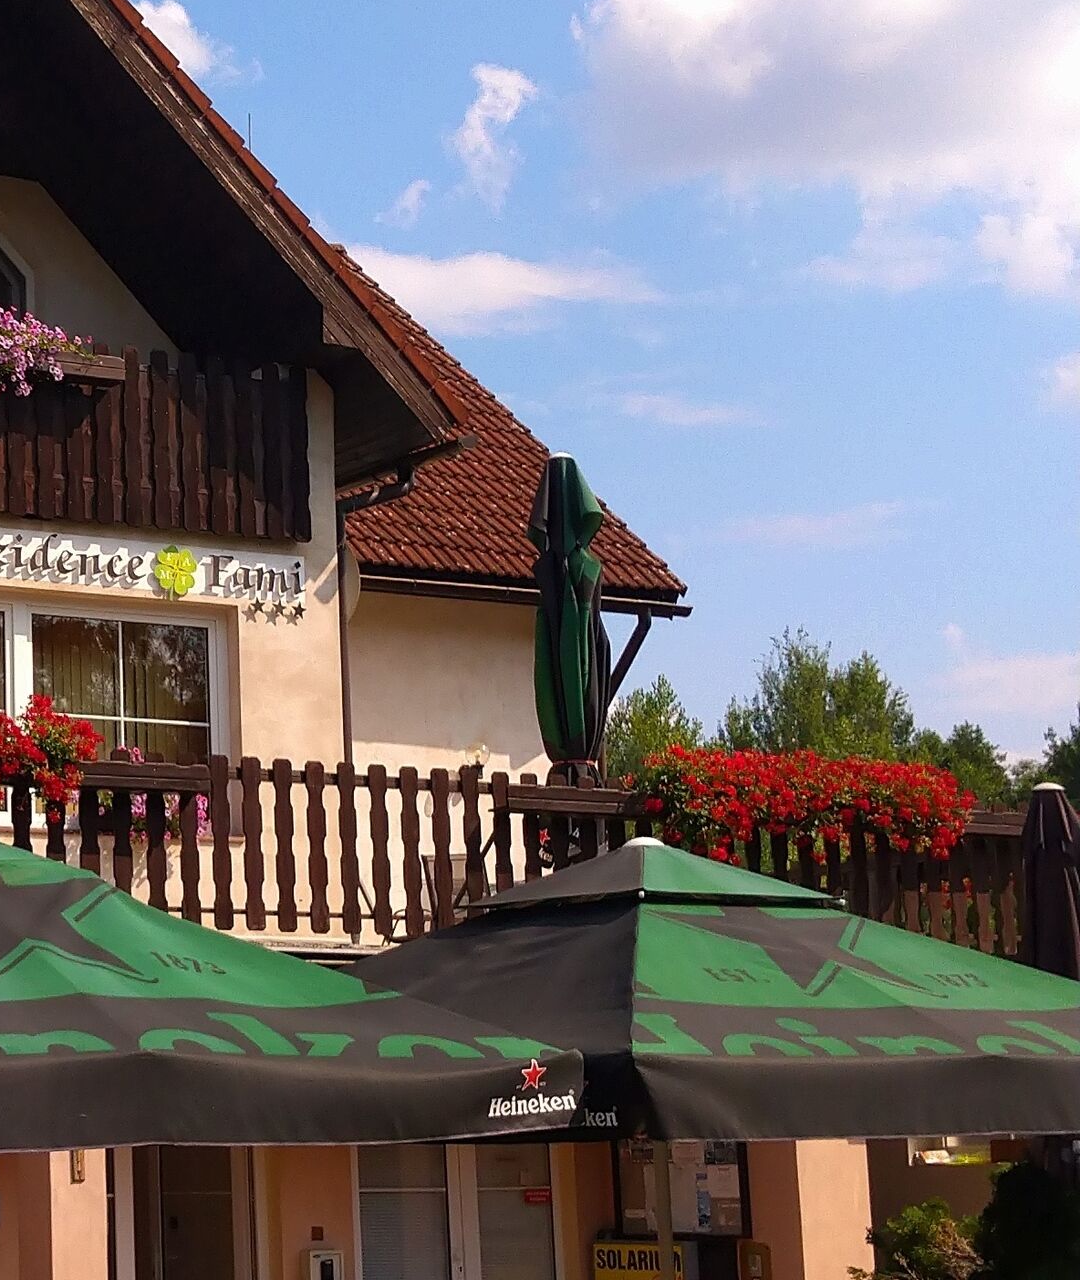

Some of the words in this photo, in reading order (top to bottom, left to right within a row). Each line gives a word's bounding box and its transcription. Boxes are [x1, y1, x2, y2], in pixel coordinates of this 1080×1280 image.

[208, 554, 307, 596] Fami
[151, 951, 227, 975] 1873
[488, 1093, 577, 1118] Heineken
